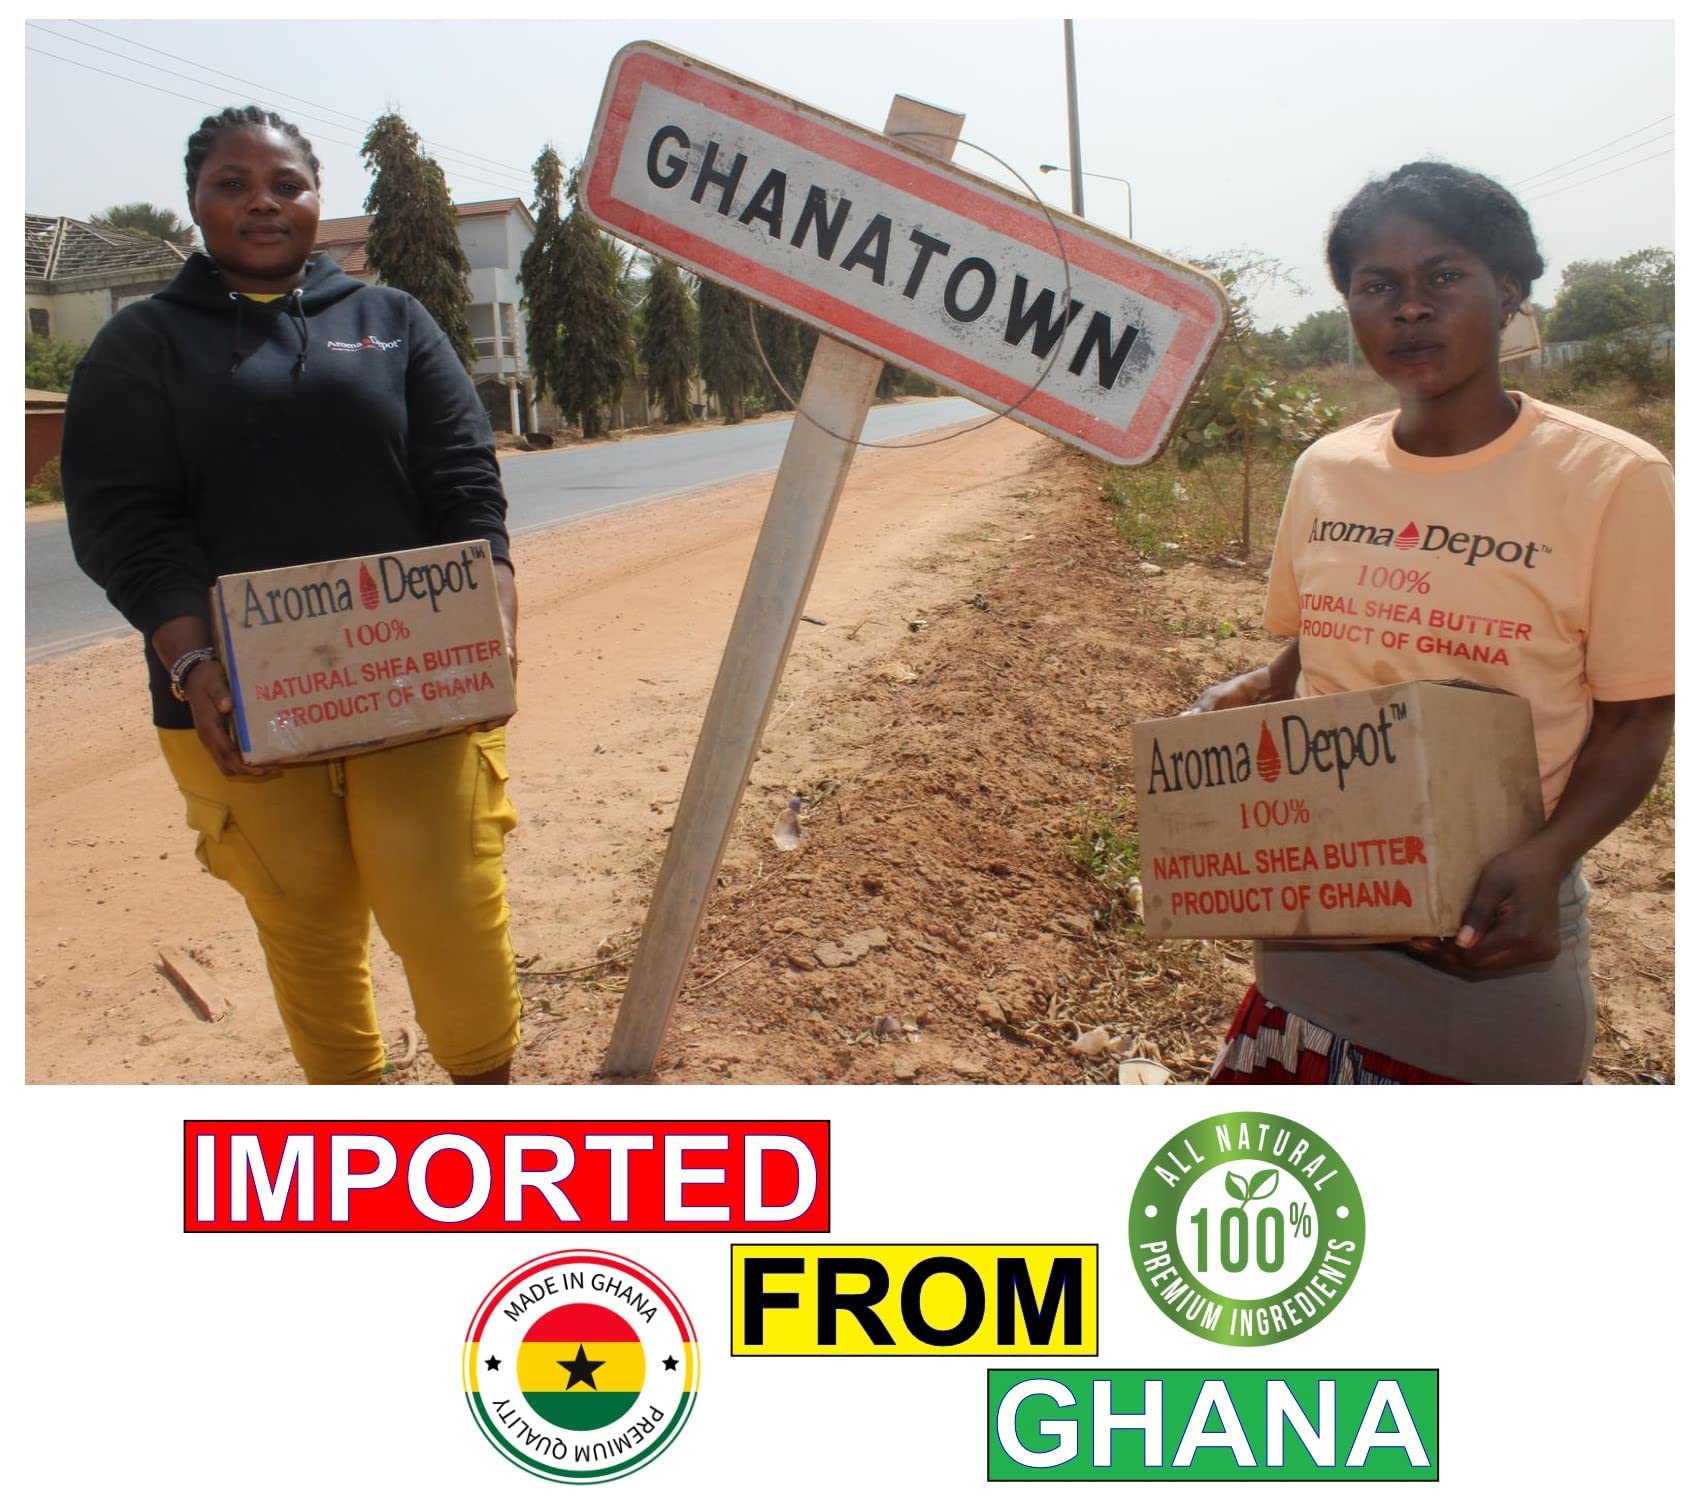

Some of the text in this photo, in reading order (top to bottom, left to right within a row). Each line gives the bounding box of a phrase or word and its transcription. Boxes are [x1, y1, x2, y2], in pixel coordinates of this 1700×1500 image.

[646, 124, 1140, 391] GHANATOWN
[327, 340, 363, 349] Aroma
[1308, 517, 1394, 547] Aroma
[1357, 565, 1431, 595] 100%
[243, 578, 354, 628] Aroma
[1365, 600, 1422, 625] SHEA
[1428, 608, 1533, 641] BUTTER
[343, 619, 411, 649] 100%
[1381, 630, 1410, 650] OF
[1416, 635, 1510, 666] GHANA
[255, 639, 502, 702] NATURAL SHEA BUTTER
[276, 671, 495, 728] PRODUCT OF GHANA
[1147, 737, 1252, 795] Aroma
[1240, 799, 1311, 829] 100%
[1153, 835, 1428, 881] NATURAL SHEA BUTTER
[1171, 879, 1413, 916] PRODUCT OF GHANA
